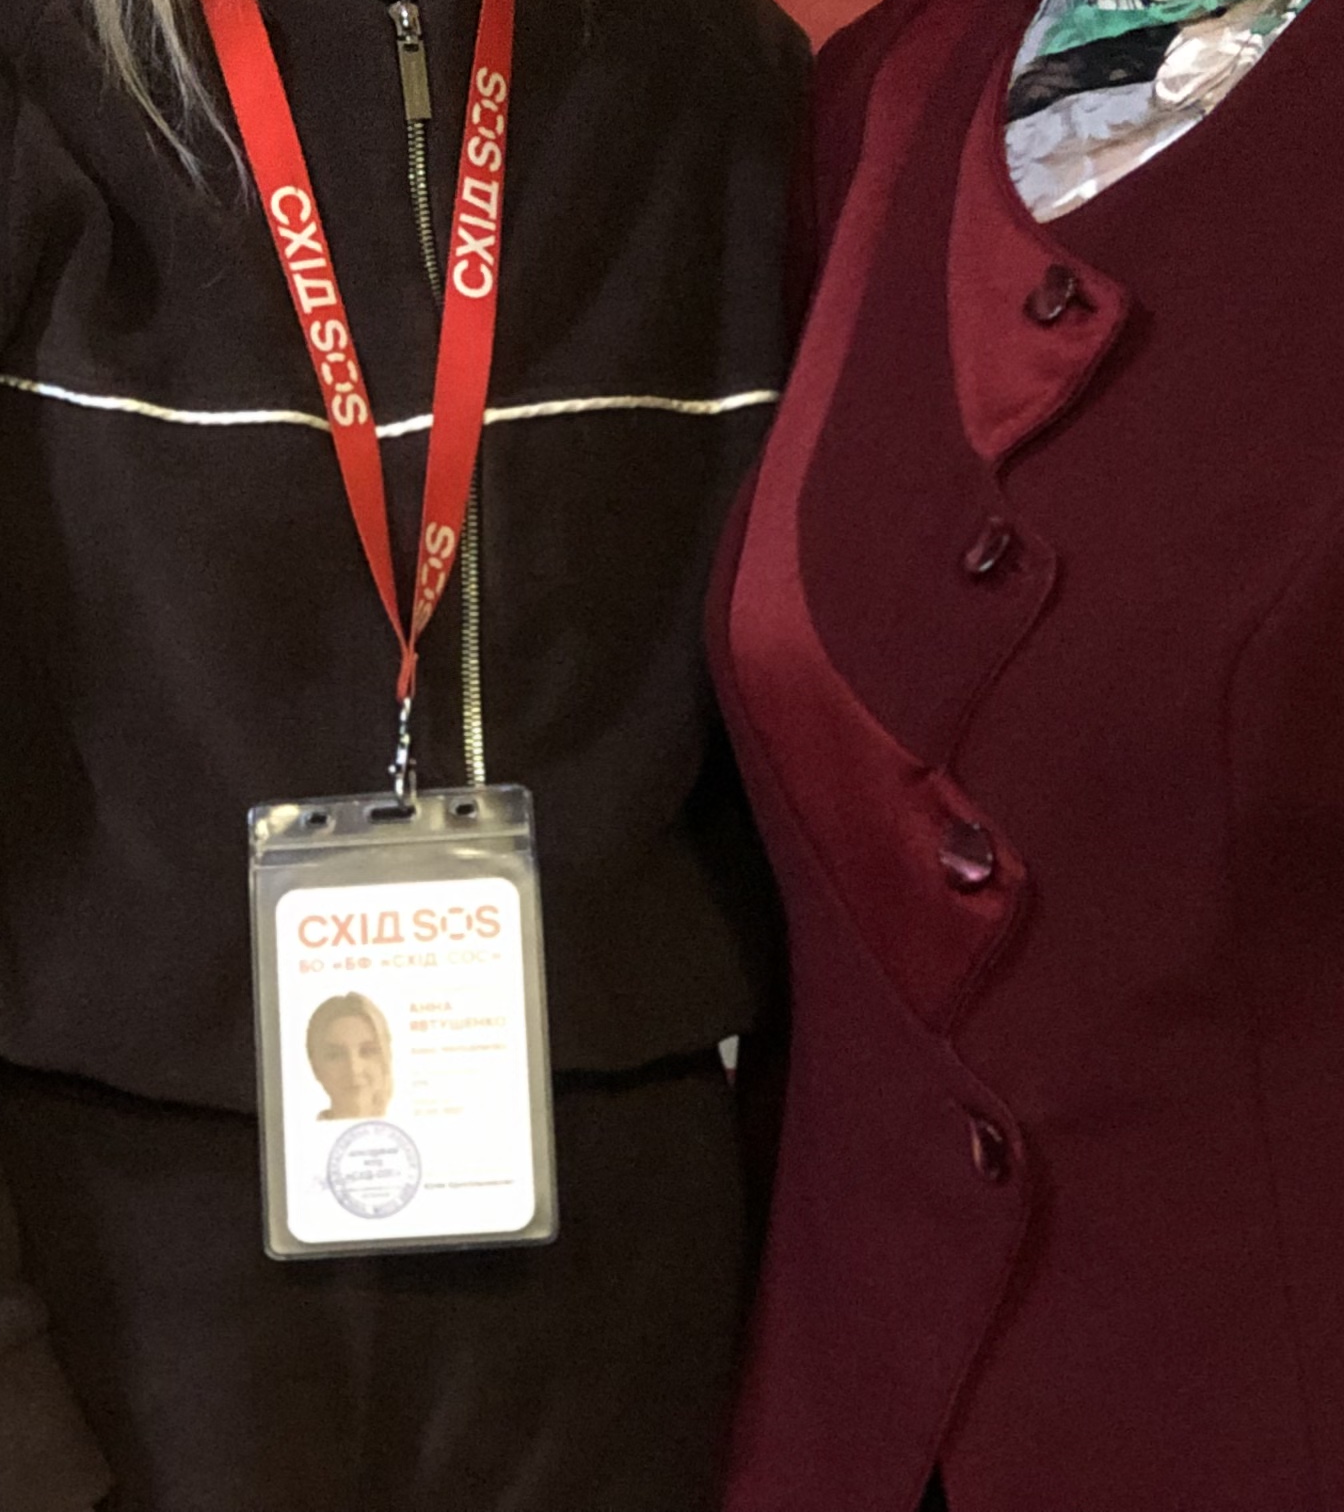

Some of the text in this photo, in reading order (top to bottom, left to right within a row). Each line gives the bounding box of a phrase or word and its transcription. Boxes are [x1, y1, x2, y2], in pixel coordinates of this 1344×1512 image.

[453, 66, 508, 299] СХІД SOS
[270, 185, 368, 427] СХІД SOS
[297, 904, 502, 949] СХІД SOS
